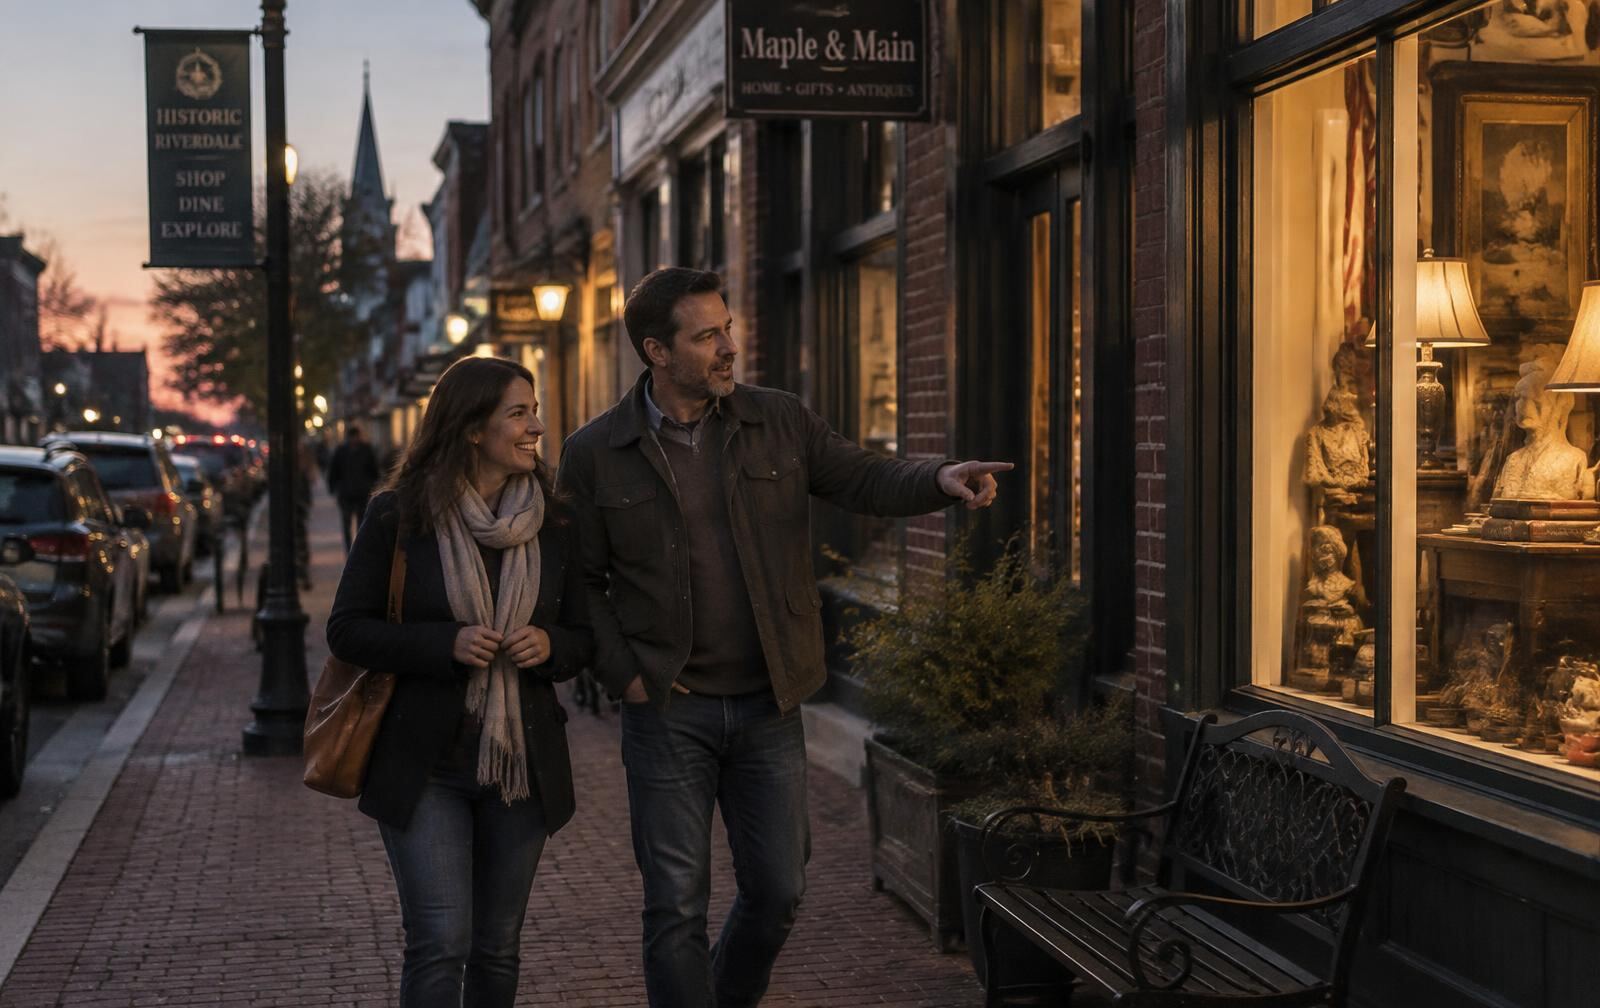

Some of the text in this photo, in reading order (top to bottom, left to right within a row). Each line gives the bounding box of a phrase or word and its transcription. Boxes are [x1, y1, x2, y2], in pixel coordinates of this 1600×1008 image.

[740, 27, 916, 69] Maple & Main
[741, 81, 914, 98] HOME GIFTS ANTIQUES
[156, 108, 242, 126] HISTORIC
[155, 133, 243, 149] RIVERDALE
[175, 170, 226, 187] SHOP
[179, 196, 225, 213] DINE
[161, 221, 242, 239] EXPLORE
